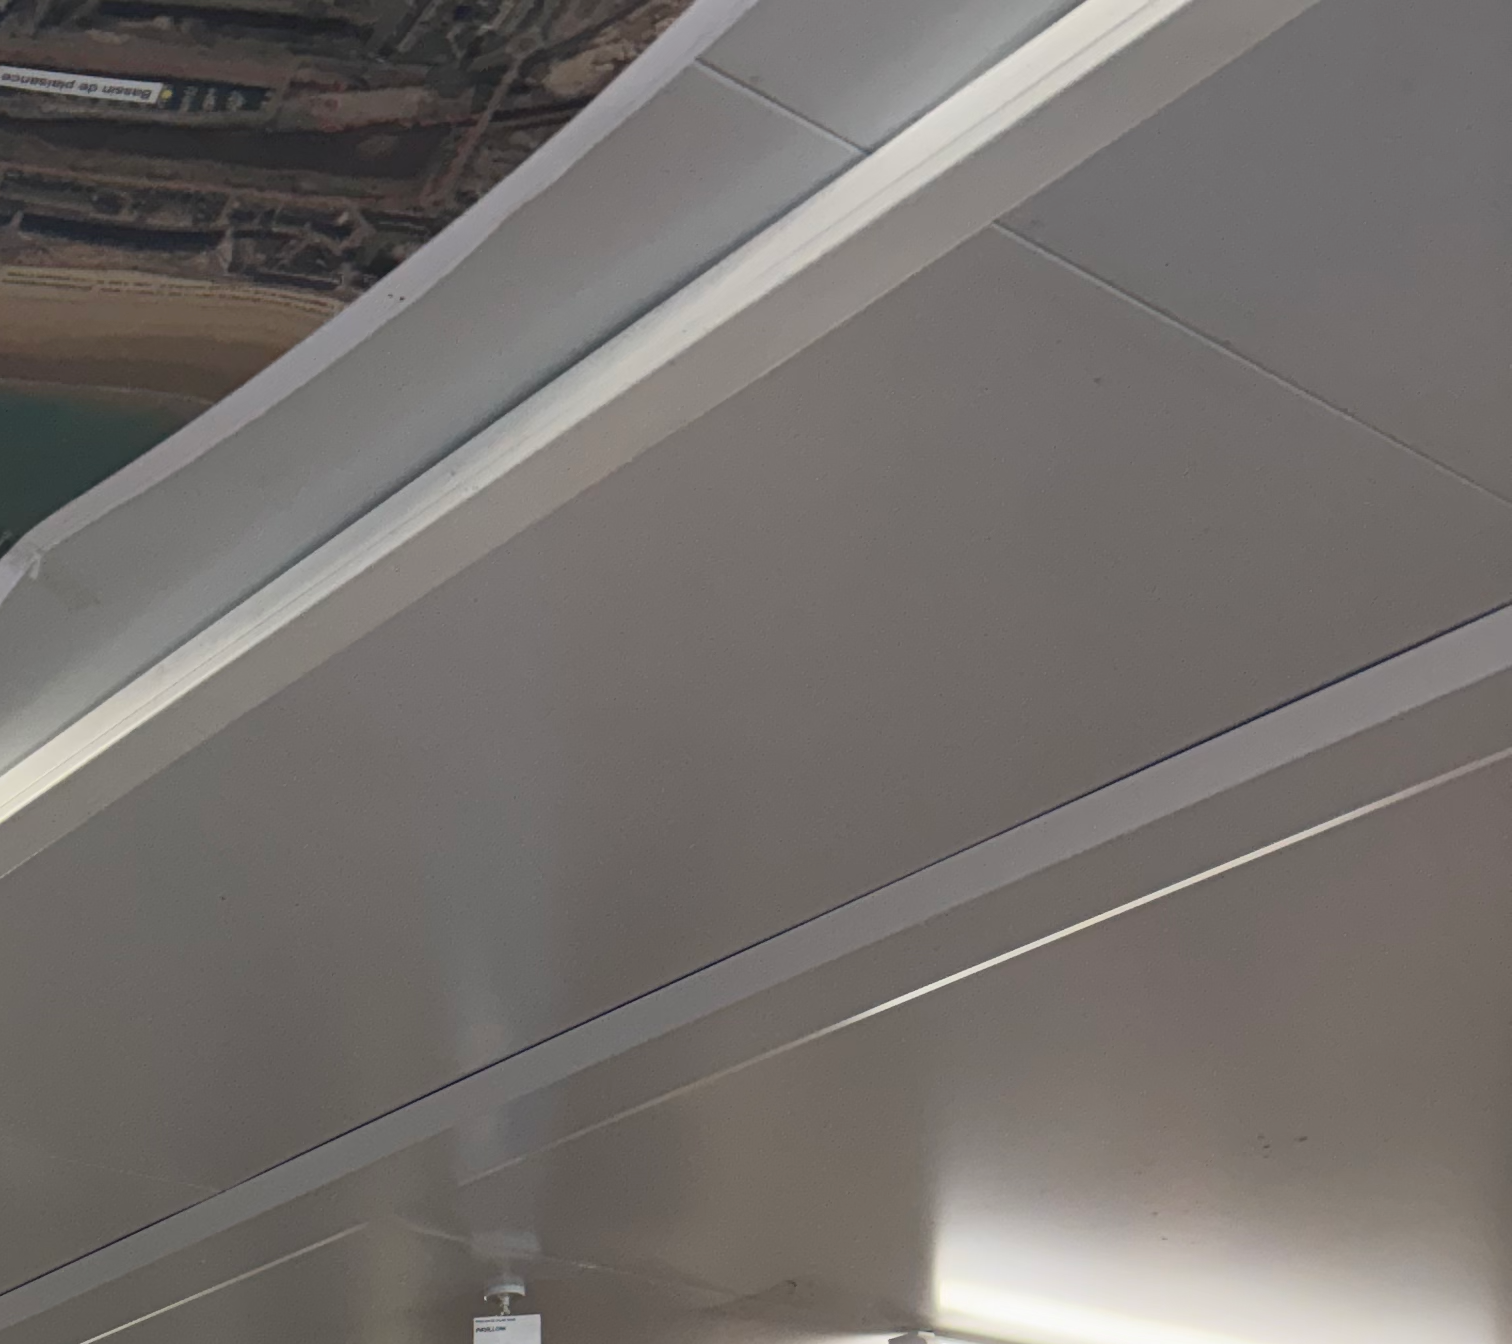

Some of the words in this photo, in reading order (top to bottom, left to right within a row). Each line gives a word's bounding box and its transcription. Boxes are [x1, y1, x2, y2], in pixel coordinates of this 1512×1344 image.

[1, 71, 75, 90] plaisance
[78, 82, 98, 92] de
[101, 85, 152, 99] Bassin
